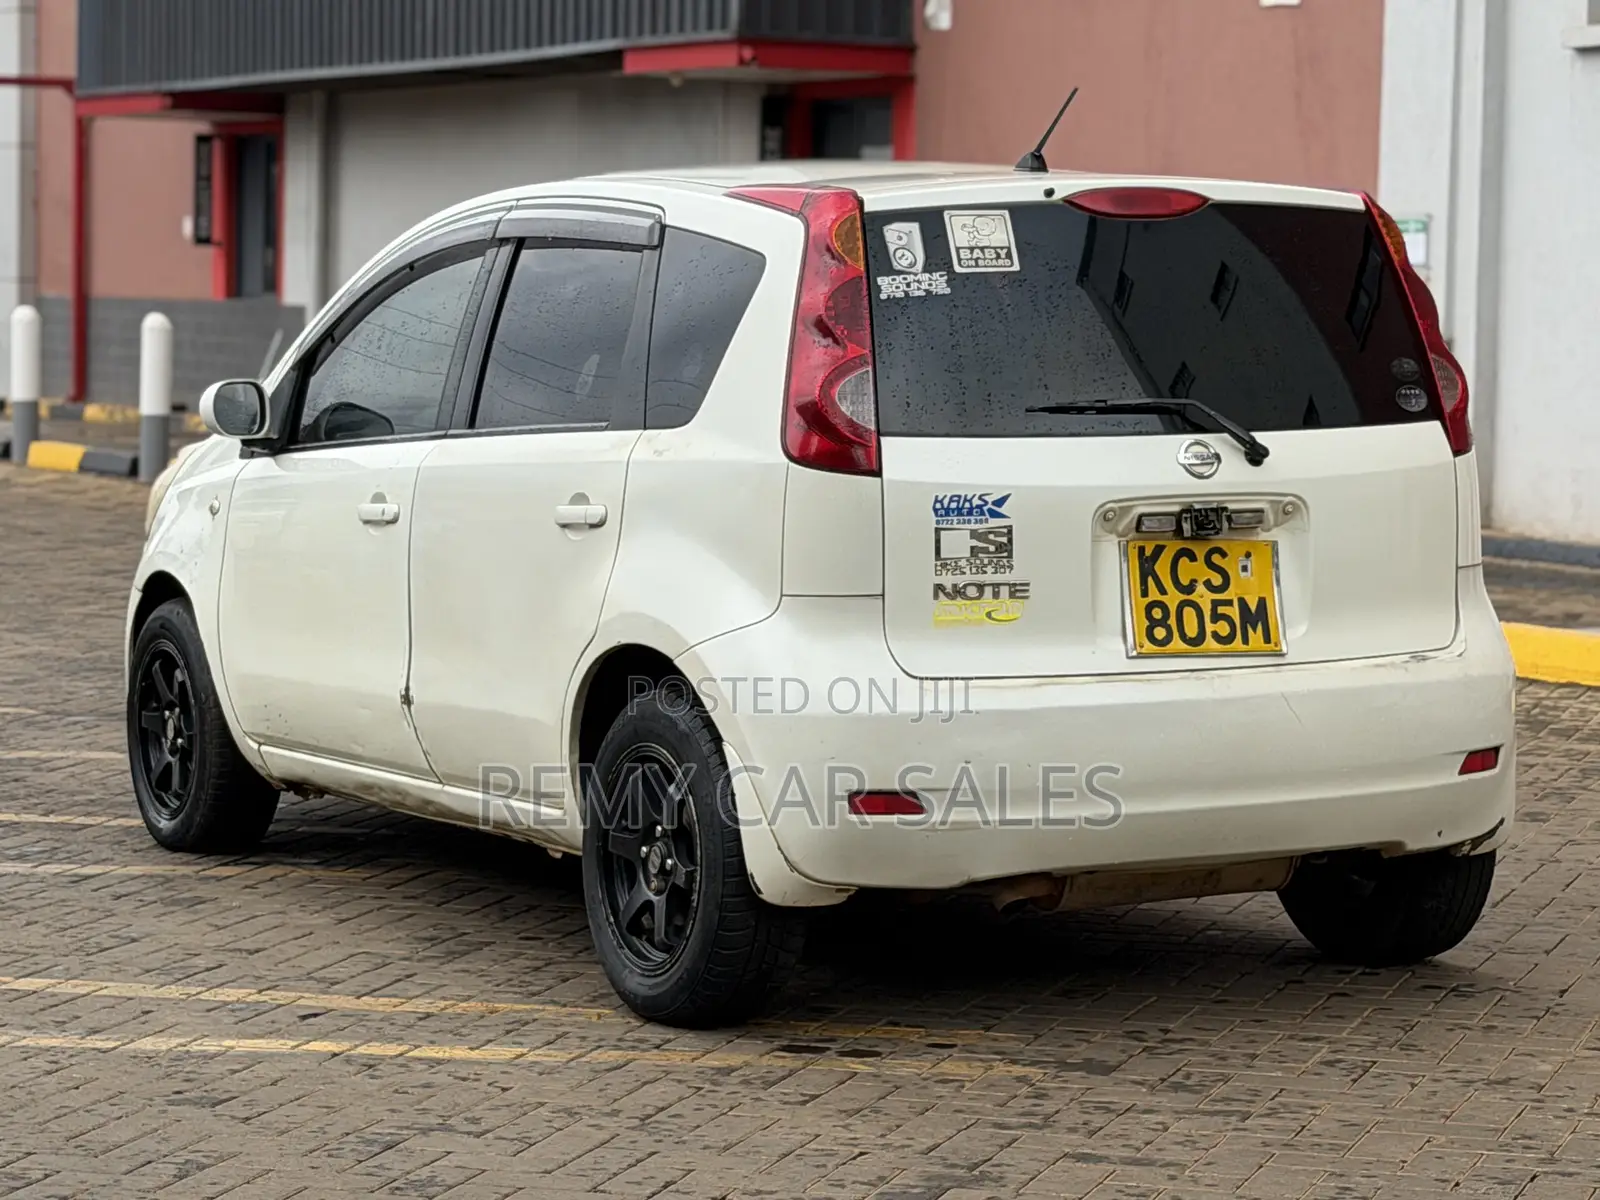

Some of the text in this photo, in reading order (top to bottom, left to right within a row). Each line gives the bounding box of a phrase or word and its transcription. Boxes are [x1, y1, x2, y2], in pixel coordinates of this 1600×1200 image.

[959, 248, 1008, 259] BABY
[960, 259, 1012, 267] ON BOARD
[876, 272, 948, 286] BOOMING
[881, 280, 948, 293] SOUNDS
[932, 492, 993, 509] KAKS
[937, 508, 981, 516] AUTO
[1137, 544, 1231, 598] KCS
[932, 582, 1031, 601] NOTE
[1145, 597, 1272, 647] 805M
